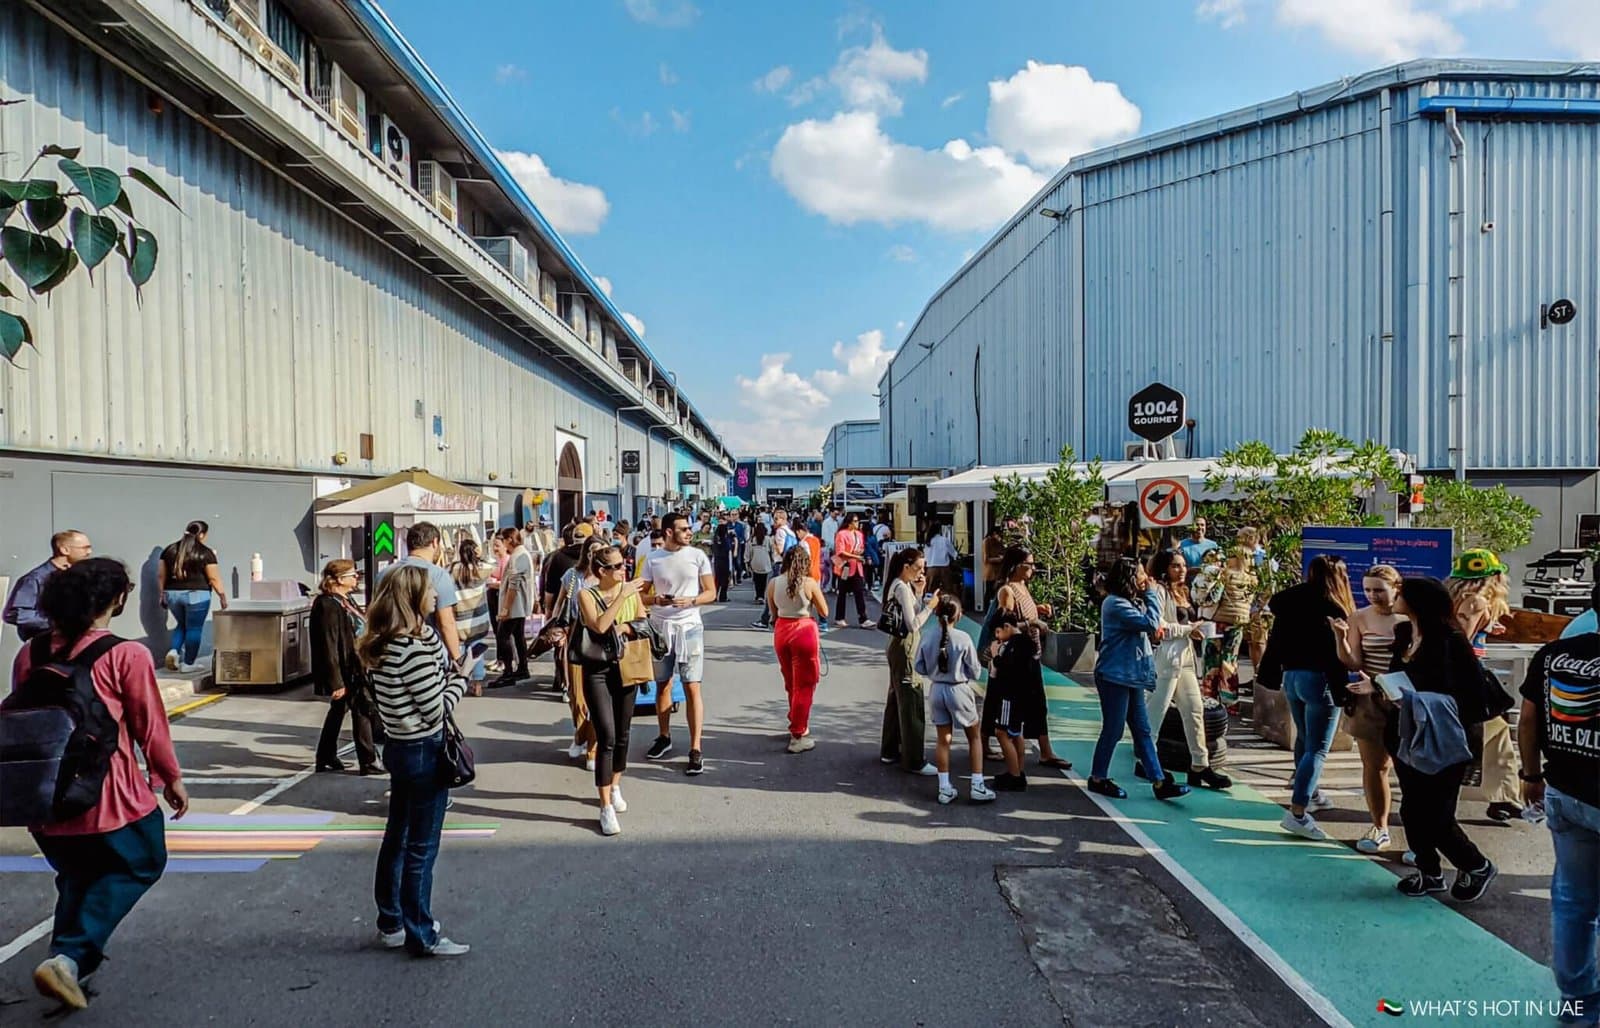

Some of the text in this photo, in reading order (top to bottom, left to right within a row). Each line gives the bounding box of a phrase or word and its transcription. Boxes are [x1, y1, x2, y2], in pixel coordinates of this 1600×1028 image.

[1134, 400, 1178, 417] 1004
[1134, 415, 1178, 425] GOURMET
[1551, 652, 1600, 677] Coca-Co
[1551, 723, 1573, 744] ICE
